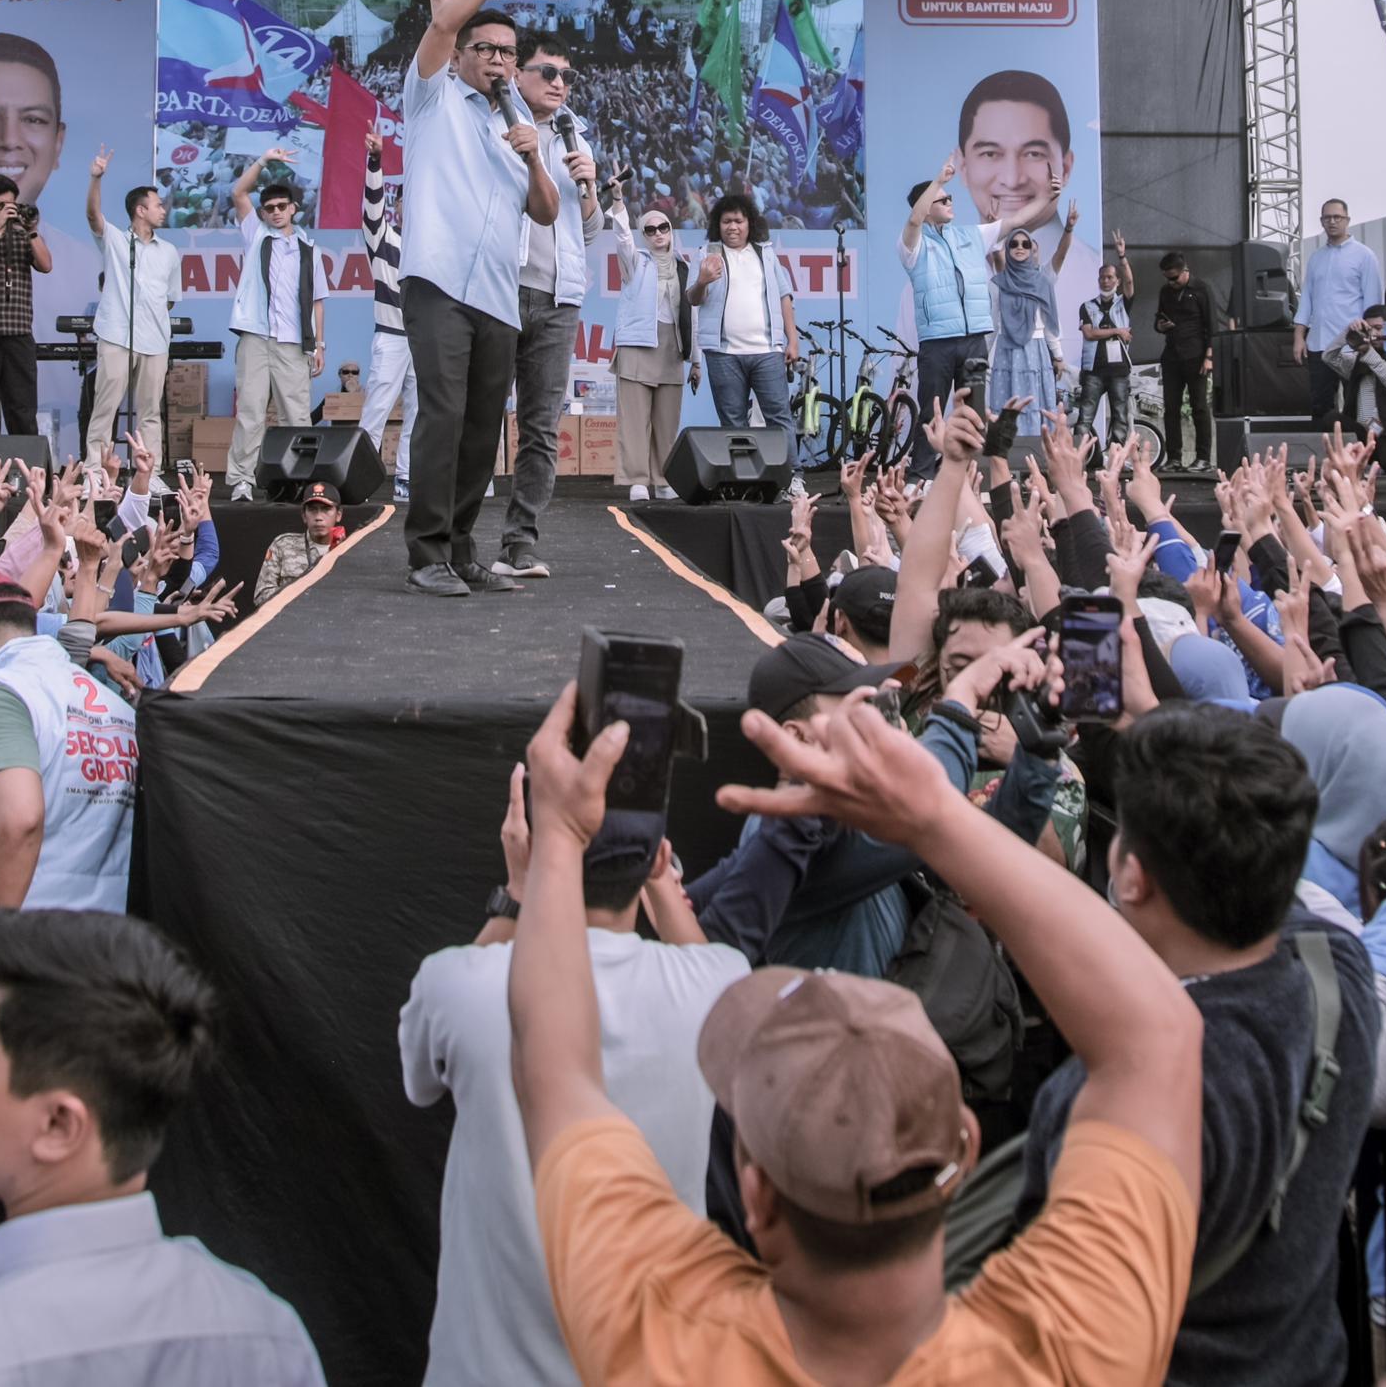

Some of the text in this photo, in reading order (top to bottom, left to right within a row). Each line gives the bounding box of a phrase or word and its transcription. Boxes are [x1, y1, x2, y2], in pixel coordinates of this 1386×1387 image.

[921, 1, 1054, 14] UNTUK BANTEN MAJU
[264, 29, 308, 70] 14
[73, 676, 109, 713] 2
[66, 730, 139, 758] SEKOLA
[81, 758, 136, 784] GRATI
